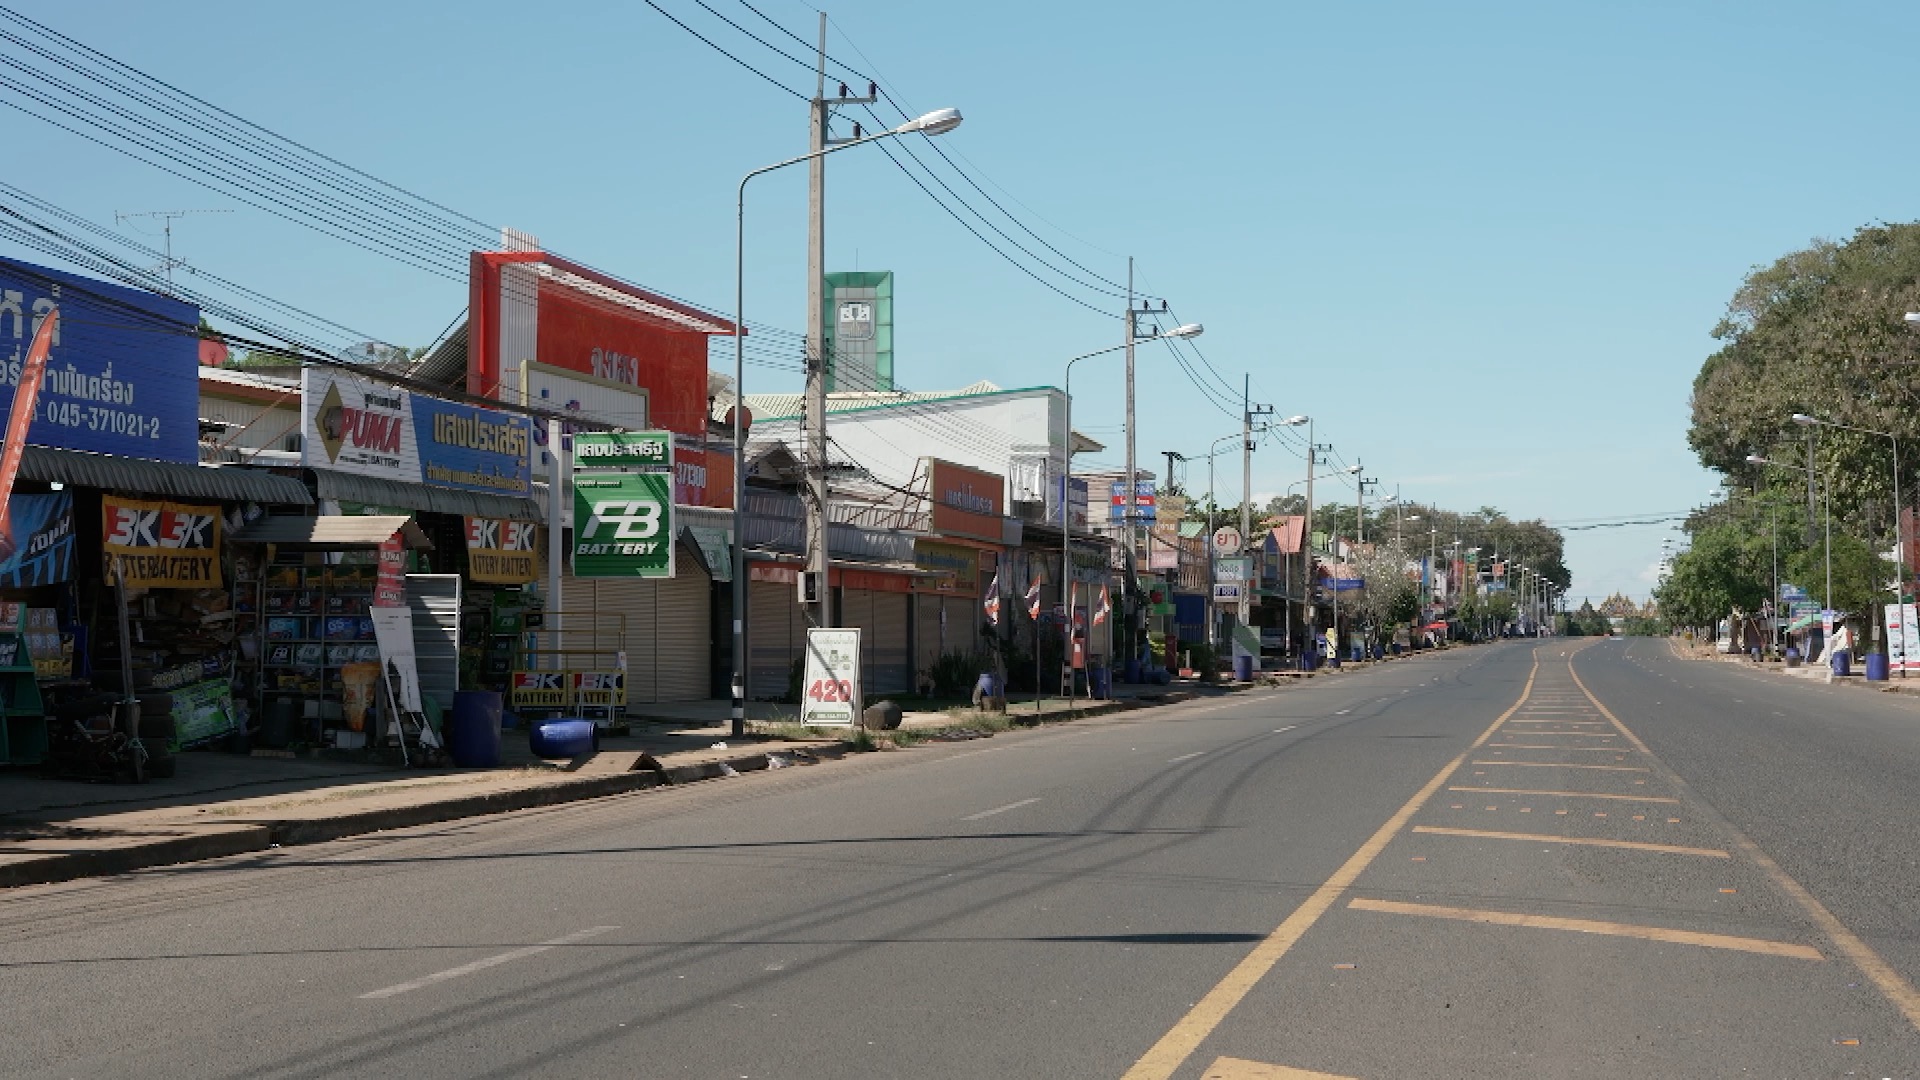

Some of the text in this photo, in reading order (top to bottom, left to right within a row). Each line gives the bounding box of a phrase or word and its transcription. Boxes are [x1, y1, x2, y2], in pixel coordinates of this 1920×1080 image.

[47, 401, 160, 439] 045-371021-2
[338, 407, 403, 455] PUMA
[434, 412, 528, 468] แสงประเสริฐ
[107, 507, 160, 547] 3K
[160, 513, 214, 550] 3K
[581, 500, 662, 538] FB
[468, 518, 535, 552] 3K 3K
[576, 543, 658, 555] BATTERY
[1217, 534, 1238, 546] ยา
[152, 556, 213, 581] BATTERY
[517, 674, 562, 690] 3K
[809, 679, 852, 702] 420
[515, 692, 563, 703] BATTERY
